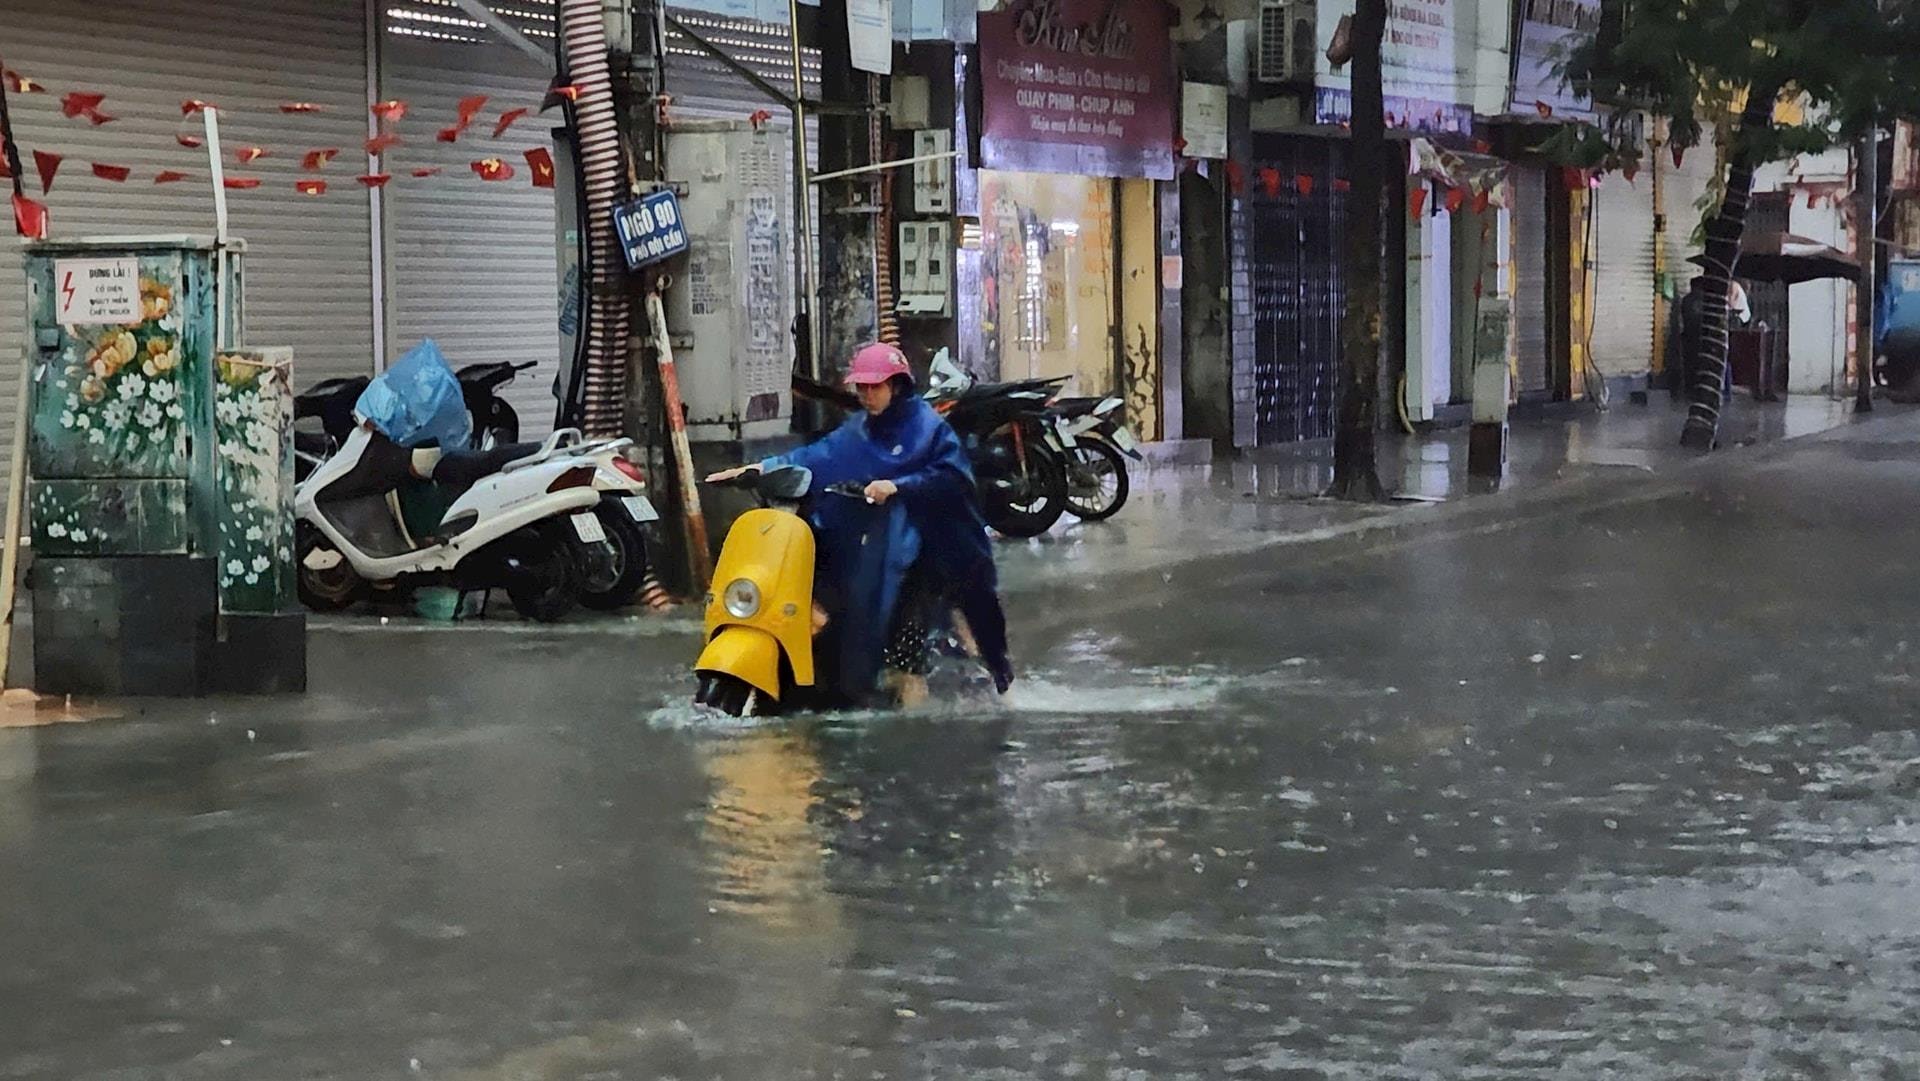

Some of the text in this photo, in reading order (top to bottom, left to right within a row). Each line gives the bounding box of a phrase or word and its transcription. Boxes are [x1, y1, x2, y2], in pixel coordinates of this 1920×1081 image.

[1016, 89, 1046, 109] QUAY
[1048, 92, 1075, 112] PHIM
[620, 199, 676, 241] NGÕ 90
